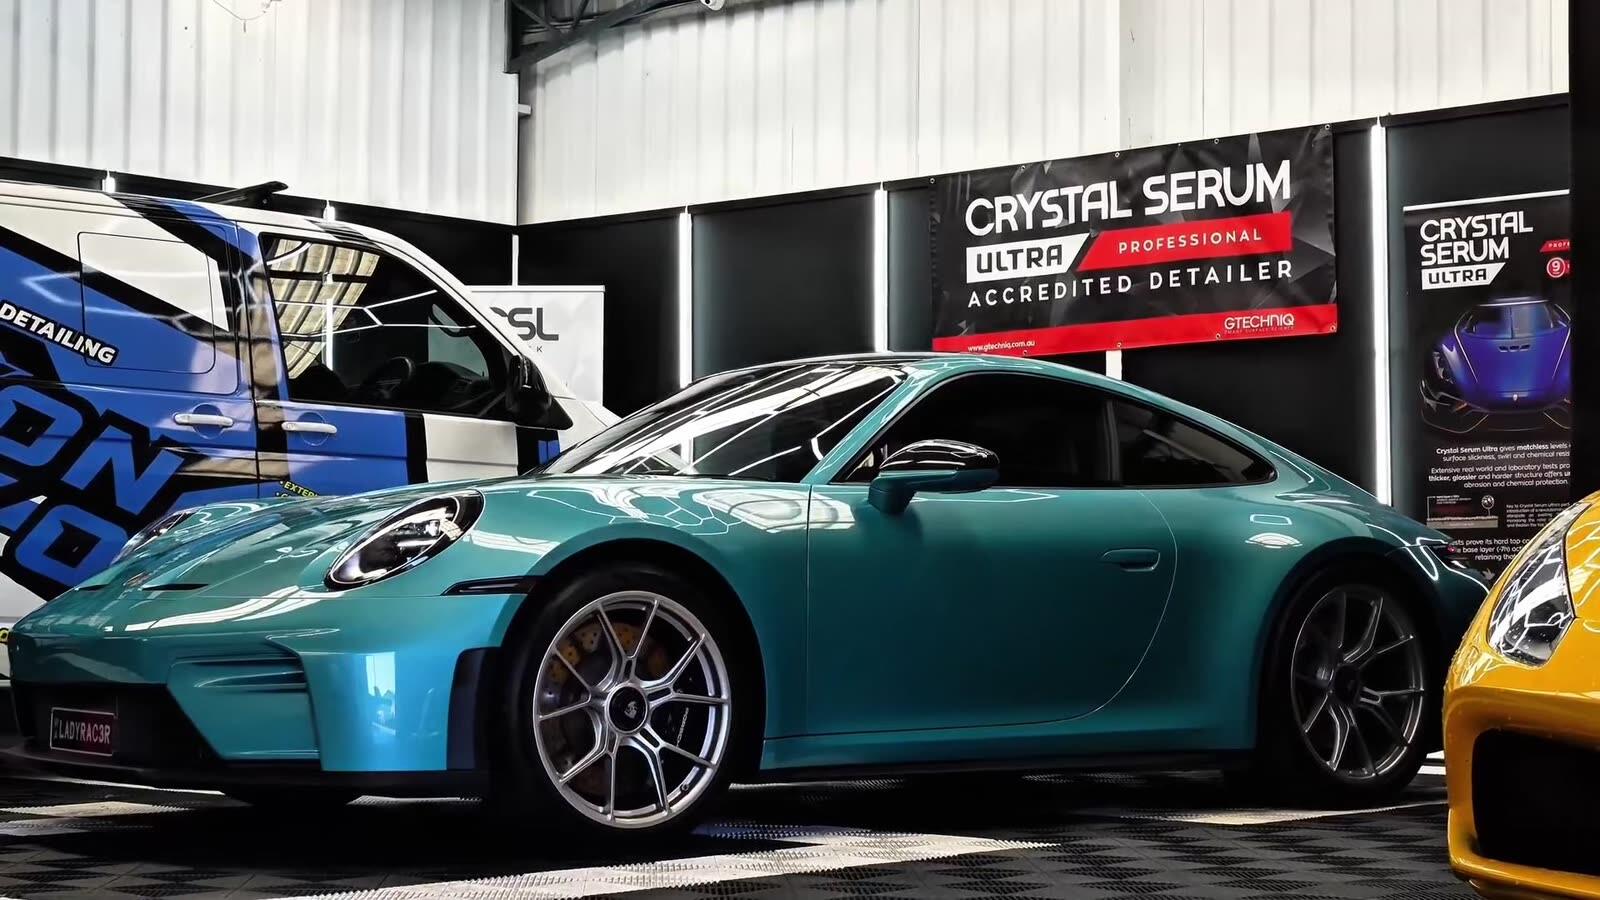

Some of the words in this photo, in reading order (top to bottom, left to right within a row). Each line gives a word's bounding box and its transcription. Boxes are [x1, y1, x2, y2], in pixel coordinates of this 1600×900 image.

[965, 180, 1133, 236] CRYSTAL
[1142, 159, 1291, 215] SERUM
[1420, 211, 1534, 242] CRYSTAL
[976, 244, 1063, 274] ULTRA
[1118, 228, 1262, 254] PROFESSIONAL
[1420, 236, 1509, 266] SERUM
[968, 275, 1132, 307] ACCREDITED
[1150, 259, 1292, 289] DETAILER
[1428, 268, 1487, 285] ULTRA
[0, 303, 116, 364] DETAILING
[489, 306, 559, 341] SL
[1224, 313, 1295, 330] GTECHNIQ
[967, 340, 1036, 352] www.gtechniq.com.au
[1436, 447, 1459, 455] Crystal
[1452, 474, 1477, 482] glossier
[1506, 479, 1534, 487] chemical
[1480, 546, 1495, 554] layer
[59, 719, 111, 745] LADYRAC3R
